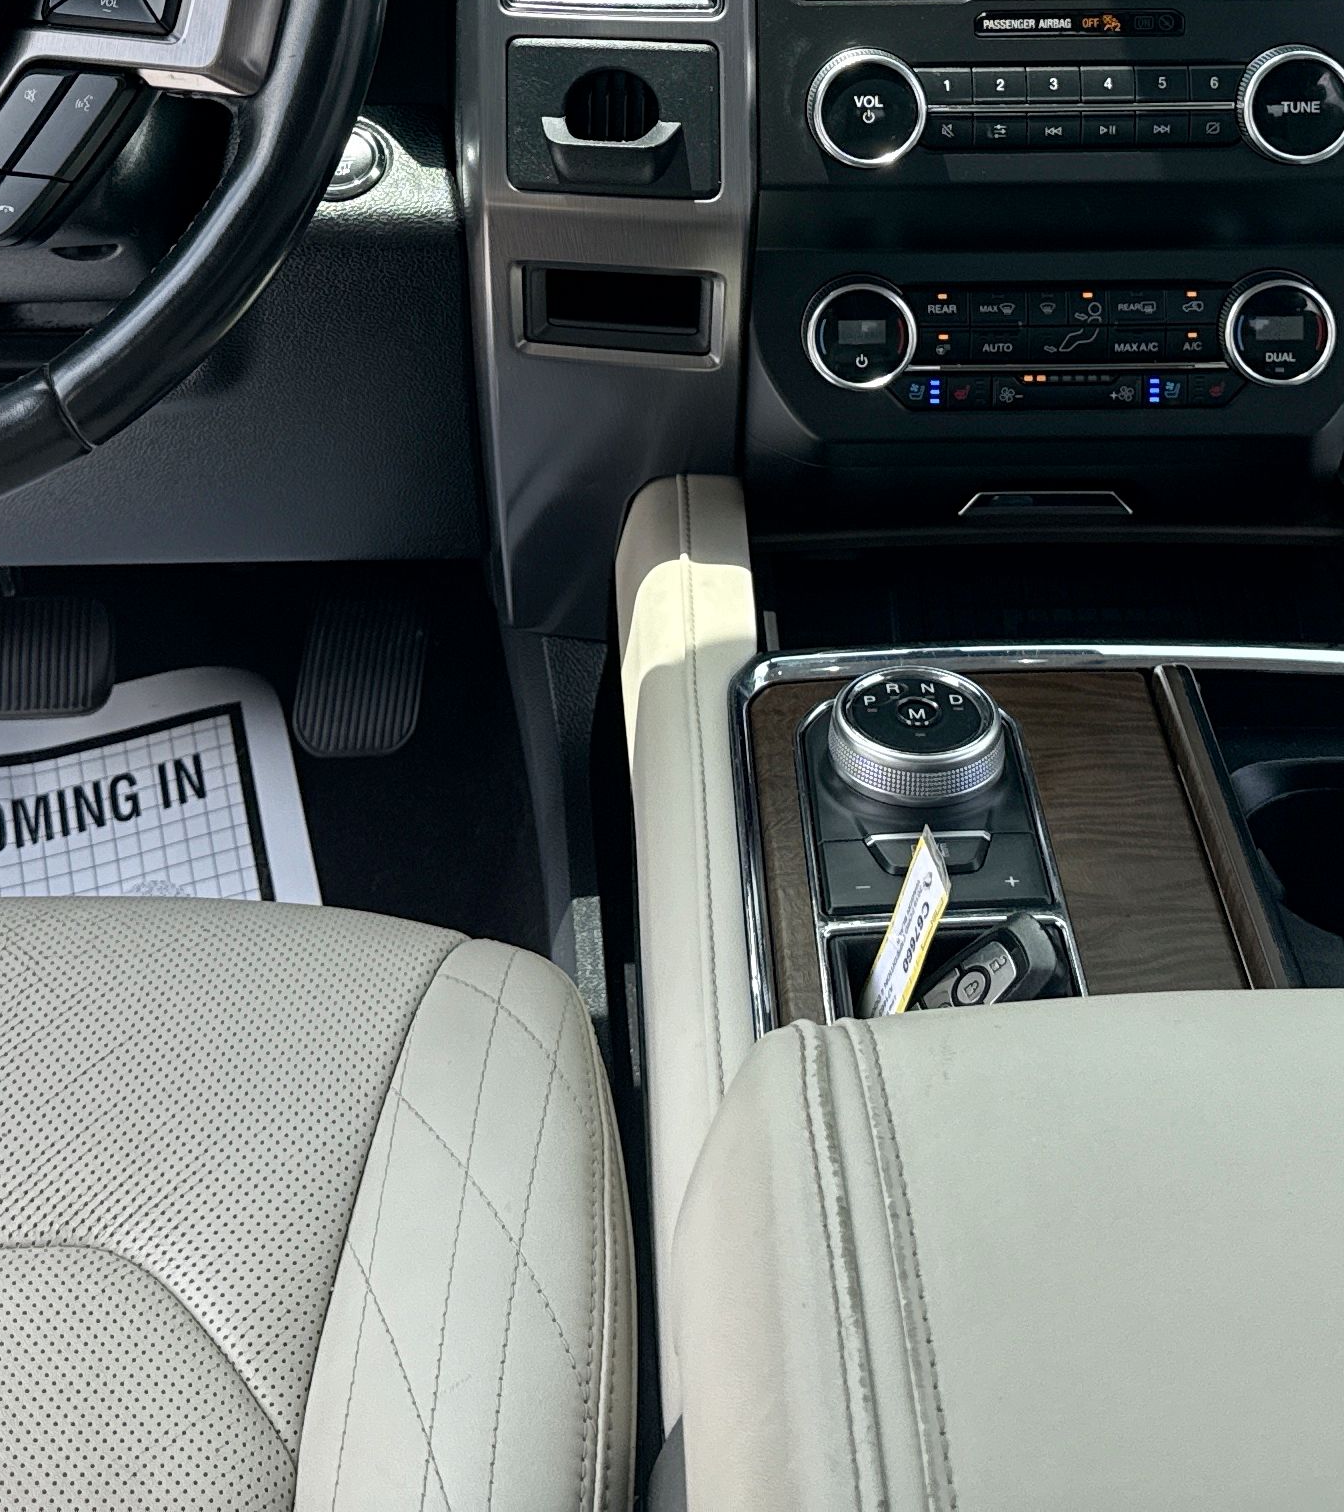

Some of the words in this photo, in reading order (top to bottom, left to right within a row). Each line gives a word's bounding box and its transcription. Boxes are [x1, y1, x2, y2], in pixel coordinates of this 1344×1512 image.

[983, 19, 1035, 29] PASSENGER
[1038, 18, 1071, 29] AIRBAG
[1082, 17, 1099, 28] OFF
[943, 79, 950, 91] 1
[996, 79, 1005, 91] 2
[1049, 78, 1058, 90] 3
[1103, 77, 1113, 89] 4
[1158, 77, 1167, 89] 5
[1210, 76, 1219, 89] 6
[854, 95, 883, 108] VOL
[1281, 101, 1320, 113] TUNE
[927, 305, 957, 314] REAR
[979, 305, 998, 313] MAX
[1118, 303, 1141, 311] REAR
[982, 343, 1013, 352] AUTO
[1114, 343, 1138, 352] MAX
[1139, 342, 1159, 352] A/C
[1183, 341, 1203, 351] A/C
[1265, 352, 1296, 362] DUAL
[885, 683, 900, 694] R
[921, 683, 936, 694] N
[863, 695, 876, 706] P
[949, 694, 963, 705] D
[908, 708, 926, 720] M
[157, 752, 208, 812] IN
